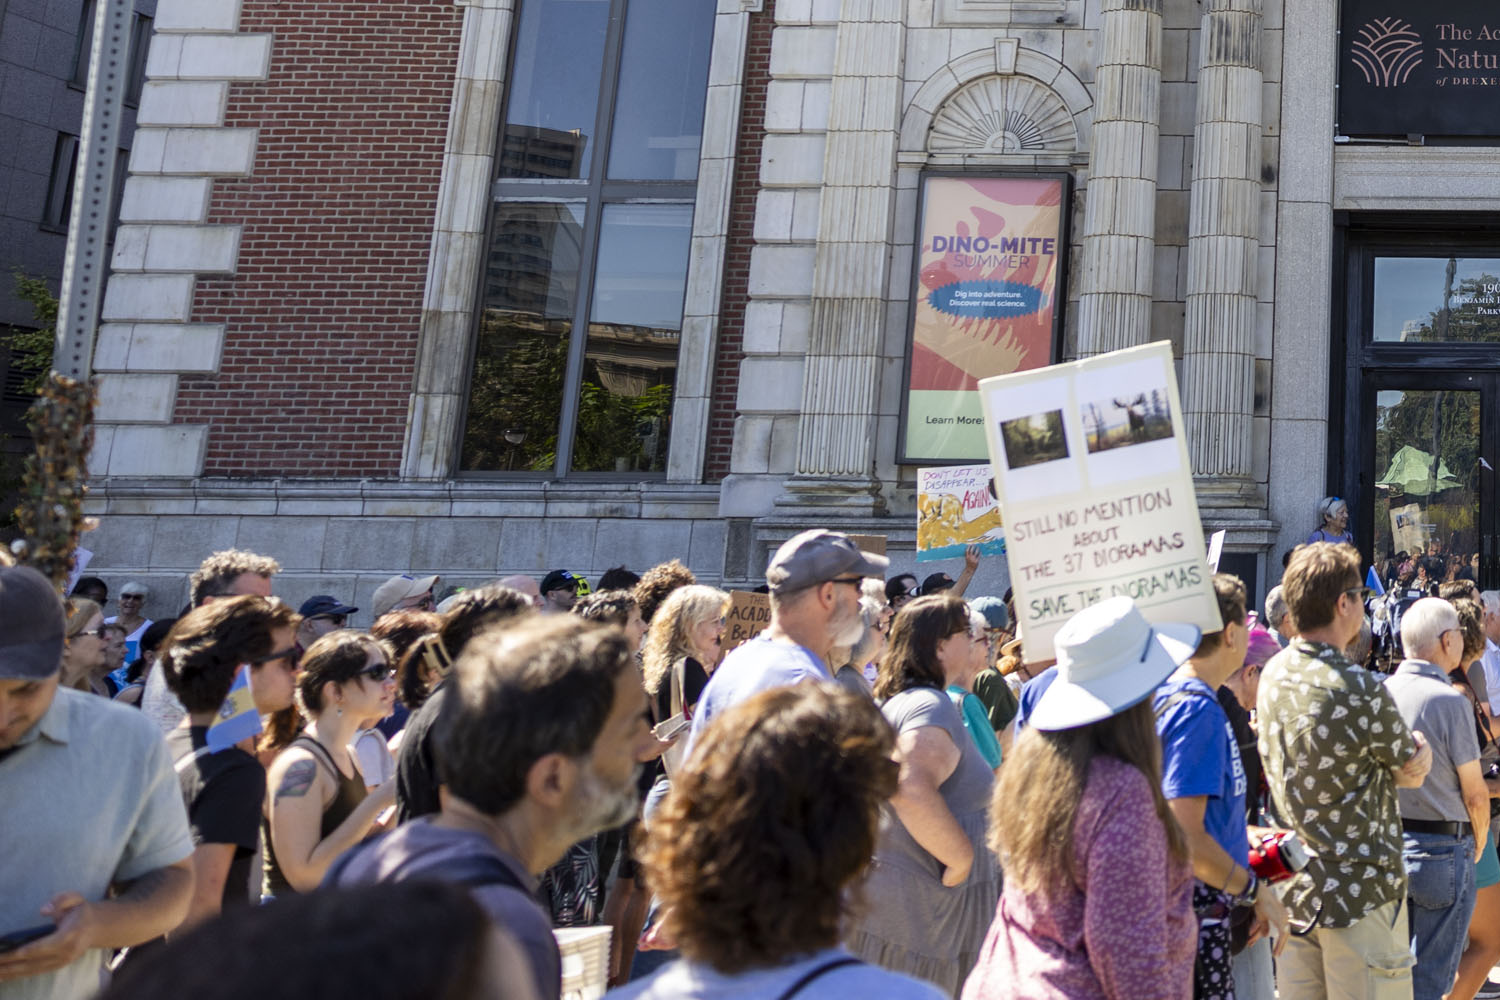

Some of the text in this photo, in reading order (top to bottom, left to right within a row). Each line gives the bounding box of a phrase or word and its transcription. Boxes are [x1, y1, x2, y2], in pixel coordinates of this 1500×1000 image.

[1436, 23, 1472, 41] The
[1436, 76, 1448, 87] of
[932, 235, 1056, 255] DINO-MITE
[953, 254, 1030, 269] SUMMER
[955, 290, 1022, 299] Dig into adventure.
[949, 299, 1026, 308] Discover real science.
[926, 415, 955, 425] Learn
[953, 468, 972, 478] LET
[962, 486, 992, 511] AGAIN!
[1013, 488, 1172, 542] STILL NO MENTION
[1073, 525, 1120, 547] ABOUT
[1020, 532, 1184, 581] THE 37 DIORAMAS
[750, 595, 766, 605] THE
[1029, 593, 1075, 620] SAVE
